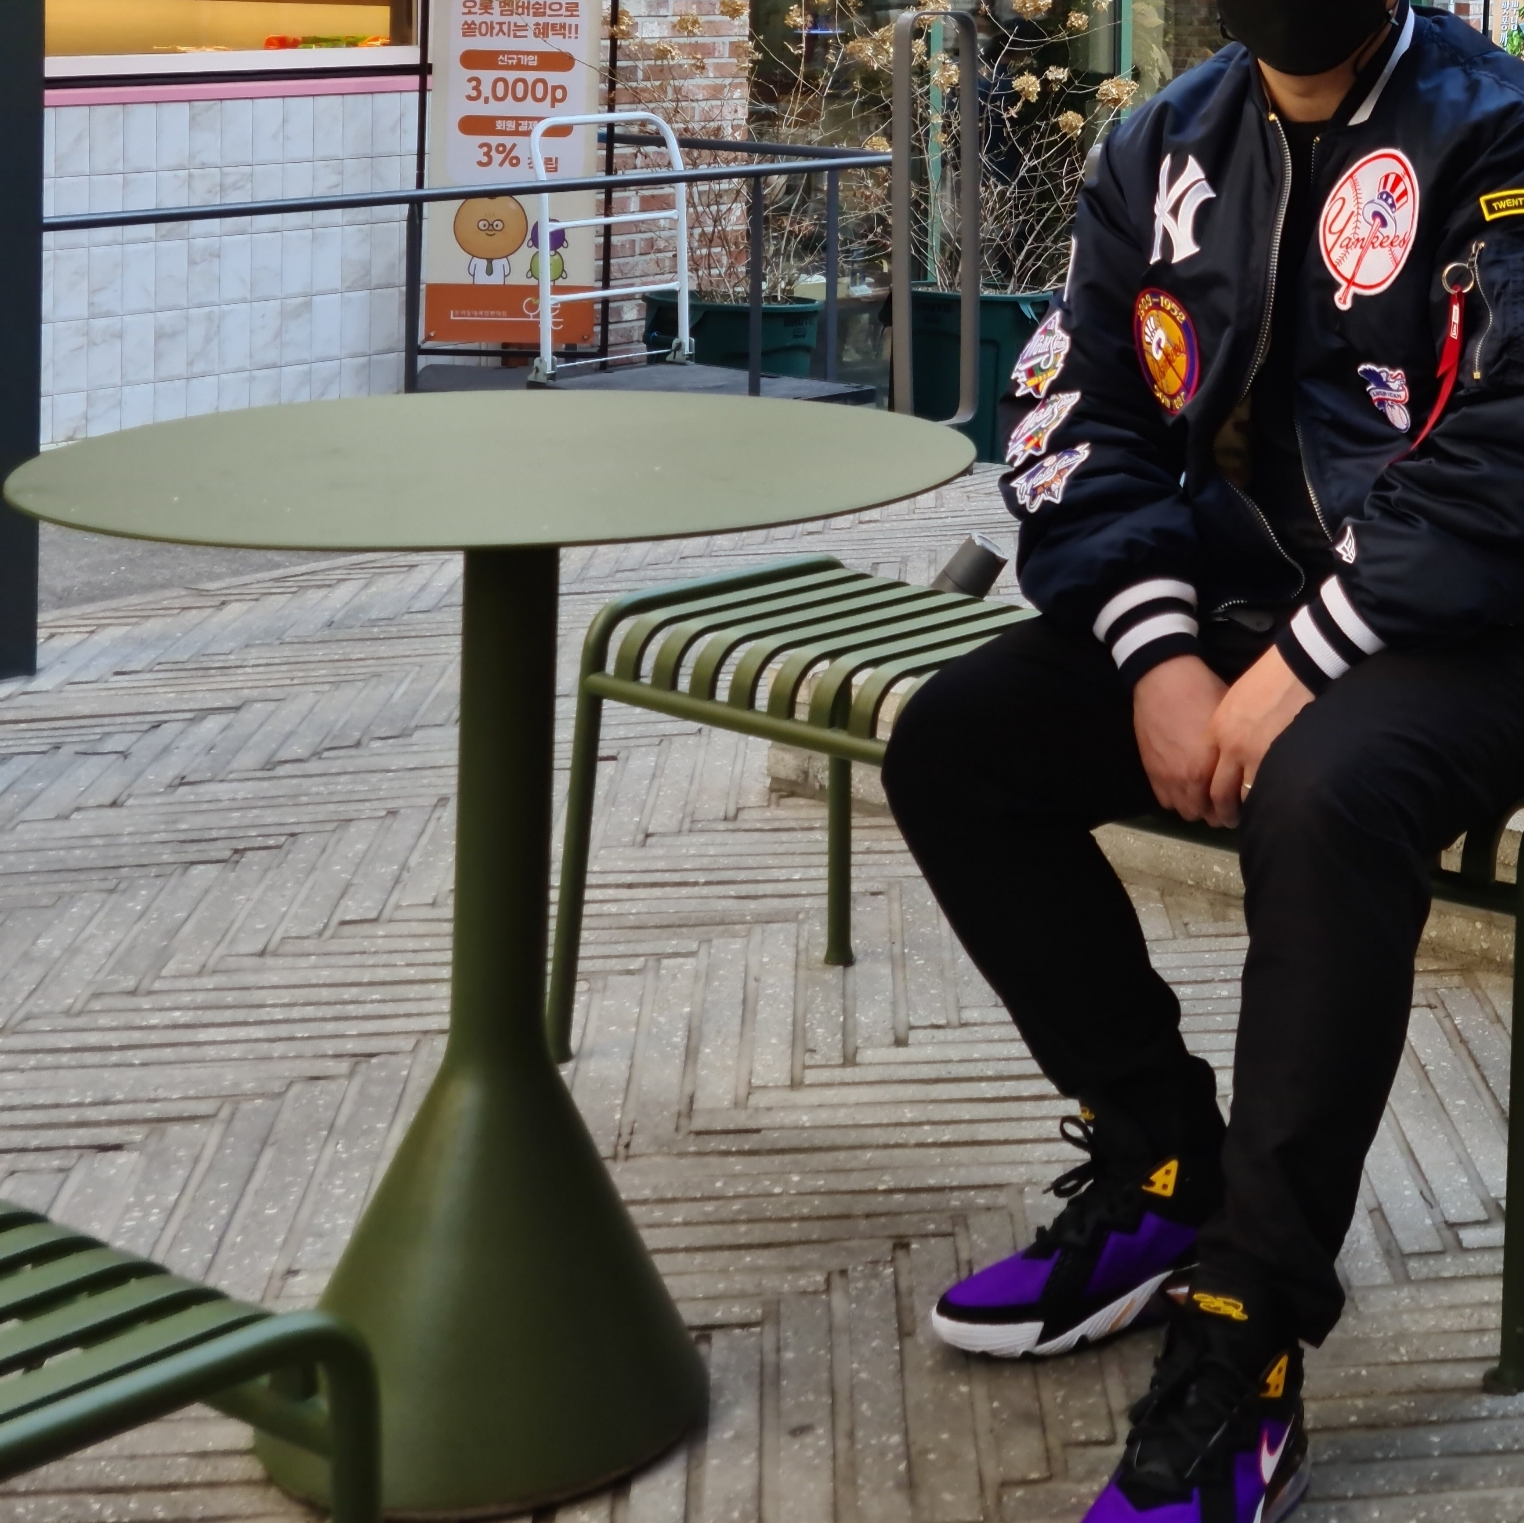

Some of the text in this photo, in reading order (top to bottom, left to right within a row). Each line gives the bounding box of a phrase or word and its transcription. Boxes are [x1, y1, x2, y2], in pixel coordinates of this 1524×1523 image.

[461, 0, 580, 18] 오롯 멤버쉽으로
[461, 20, 579, 39] 쏟아지는 혜택!!
[498, 54, 537, 66] 신규가입
[465, 76, 567, 108] 3,000p
[495, 120, 515, 131] 회원
[476, 142, 521, 168] 3%
[1328, 196, 1408, 255] Yankees
